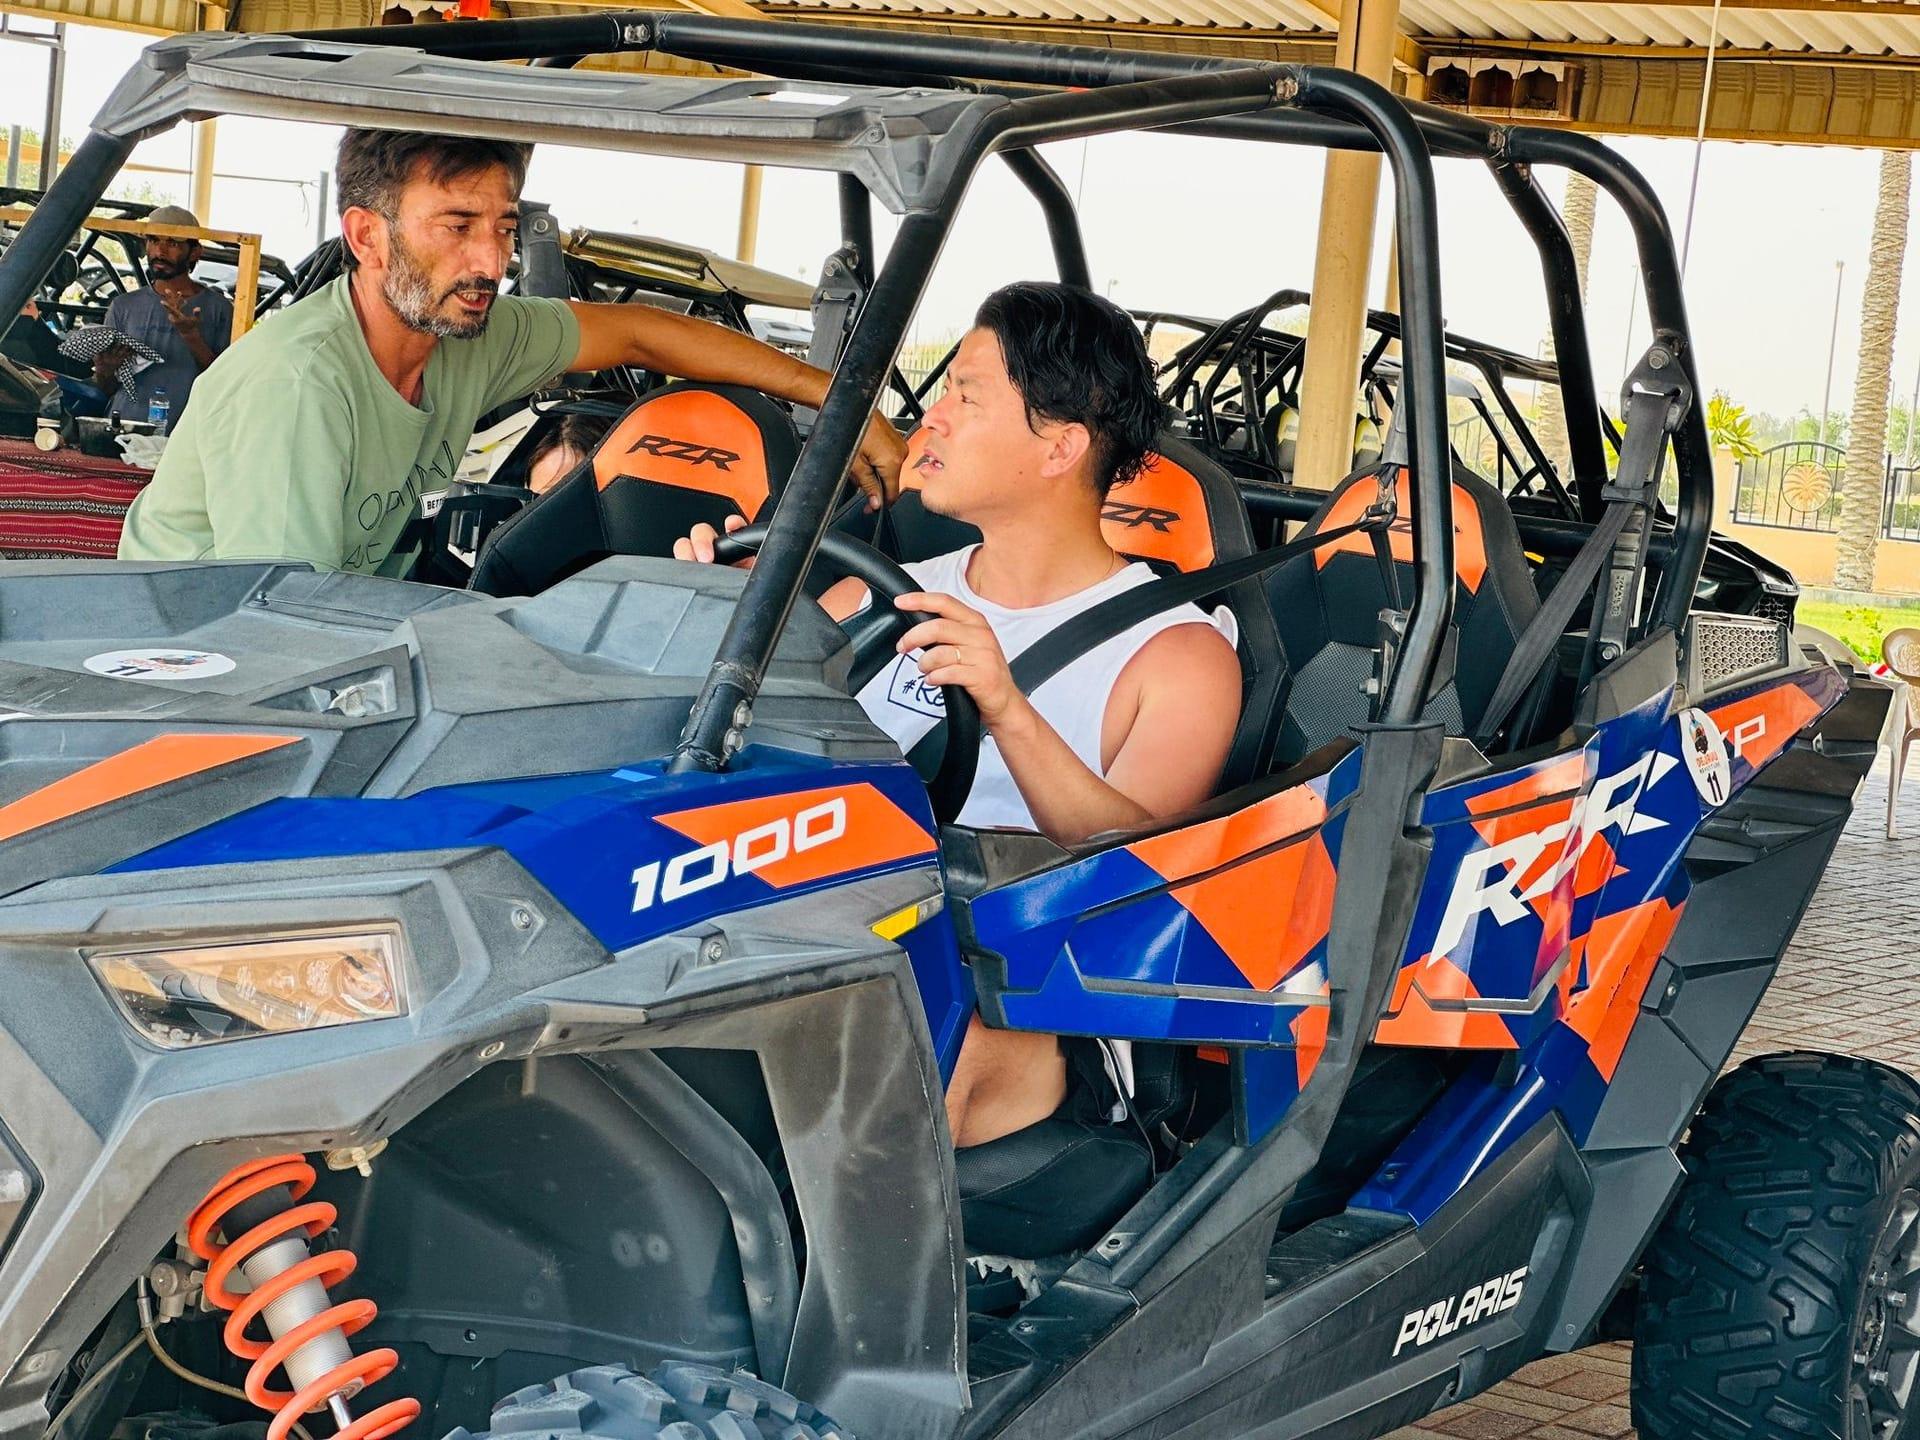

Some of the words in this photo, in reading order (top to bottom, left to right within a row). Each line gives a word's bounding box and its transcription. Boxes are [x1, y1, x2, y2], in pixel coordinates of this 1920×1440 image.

[625, 434, 741, 472] RZR
[1100, 501, 1181, 533] ZR
[1720, 713, 1767, 760] P
[1706, 771, 1723, 803] 11
[631, 797, 846, 913] 1000
[1392, 1265, 1529, 1357] POLARIS
